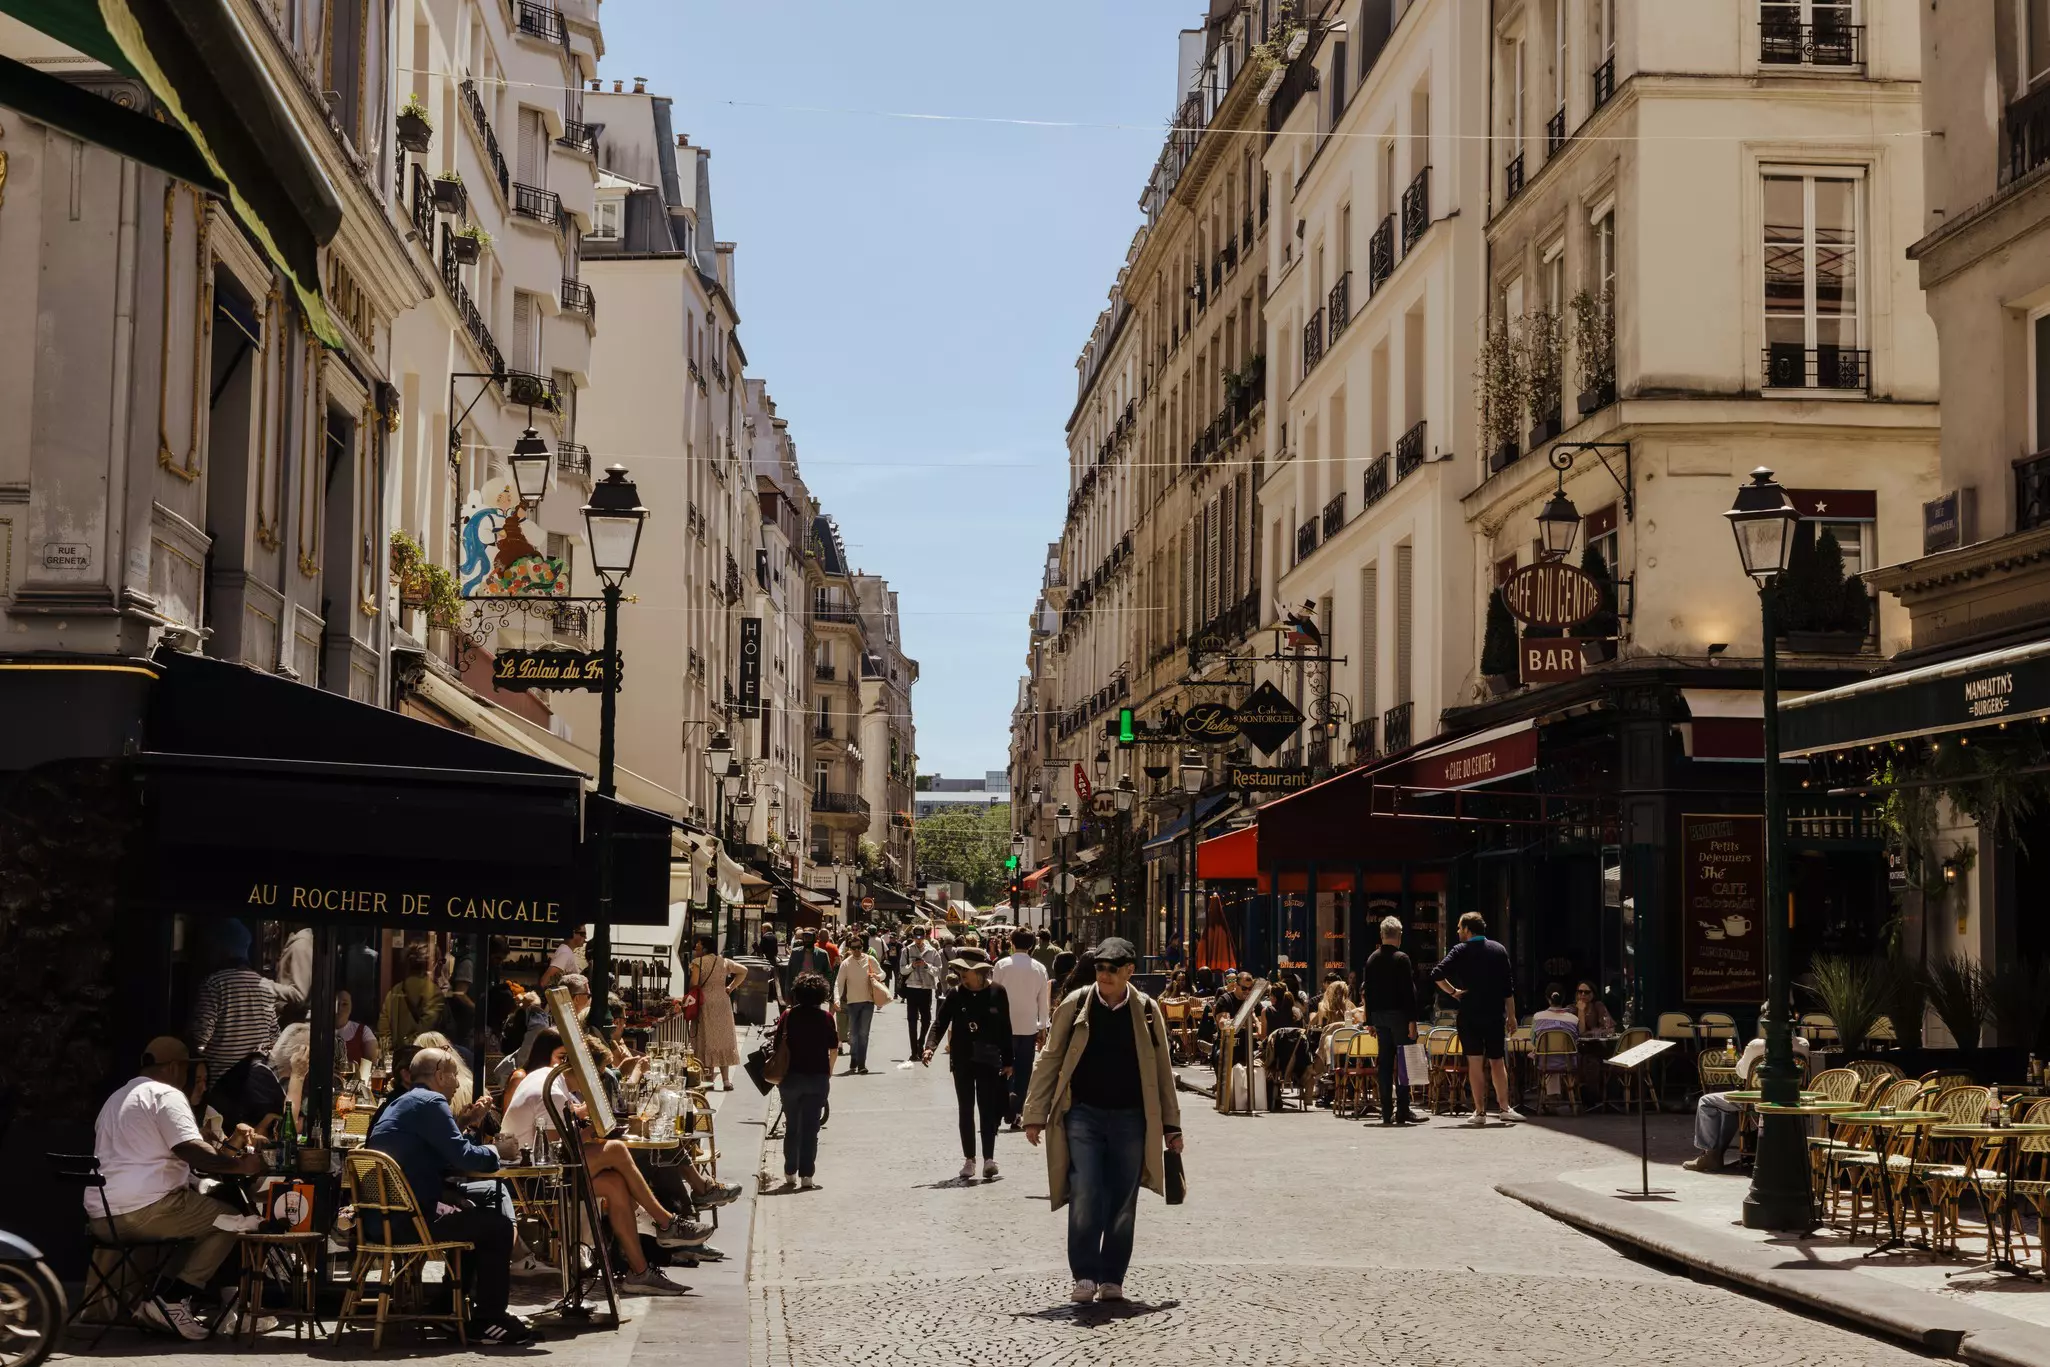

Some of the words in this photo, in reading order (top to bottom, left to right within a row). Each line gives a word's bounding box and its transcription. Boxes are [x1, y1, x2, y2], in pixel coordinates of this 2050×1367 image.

[46, 556, 87, 565] GRENETA
[58, 547, 76, 555] RUE
[1508, 570, 1532, 618] CAFE
[1536, 568, 1553, 623] DU
[1557, 568, 1598, 623] CENTRE
[496, 658, 516, 678] Le
[517, 657, 560, 679] Palais
[560, 659, 581, 679] du
[744, 623, 757, 713] HÔTEL
[1528, 649, 1575, 671] BAR
[1965, 671, 2013, 702] MANHATTN'S
[1974, 697, 2004, 717] BURGERS
[1239, 714, 1297, 724] MONTORGUEIL
[1471, 752, 1492, 776] CENTRE
[1233, 769, 1308, 788] Restaurant
[1092, 799, 1118, 812] CAF
[1700, 866, 1726, 880] Thé
[247, 885, 279, 905] AU
[292, 886, 389, 913] ROCHER
[402, 894, 431, 915] DE
[447, 897, 560, 924] CANCALE
